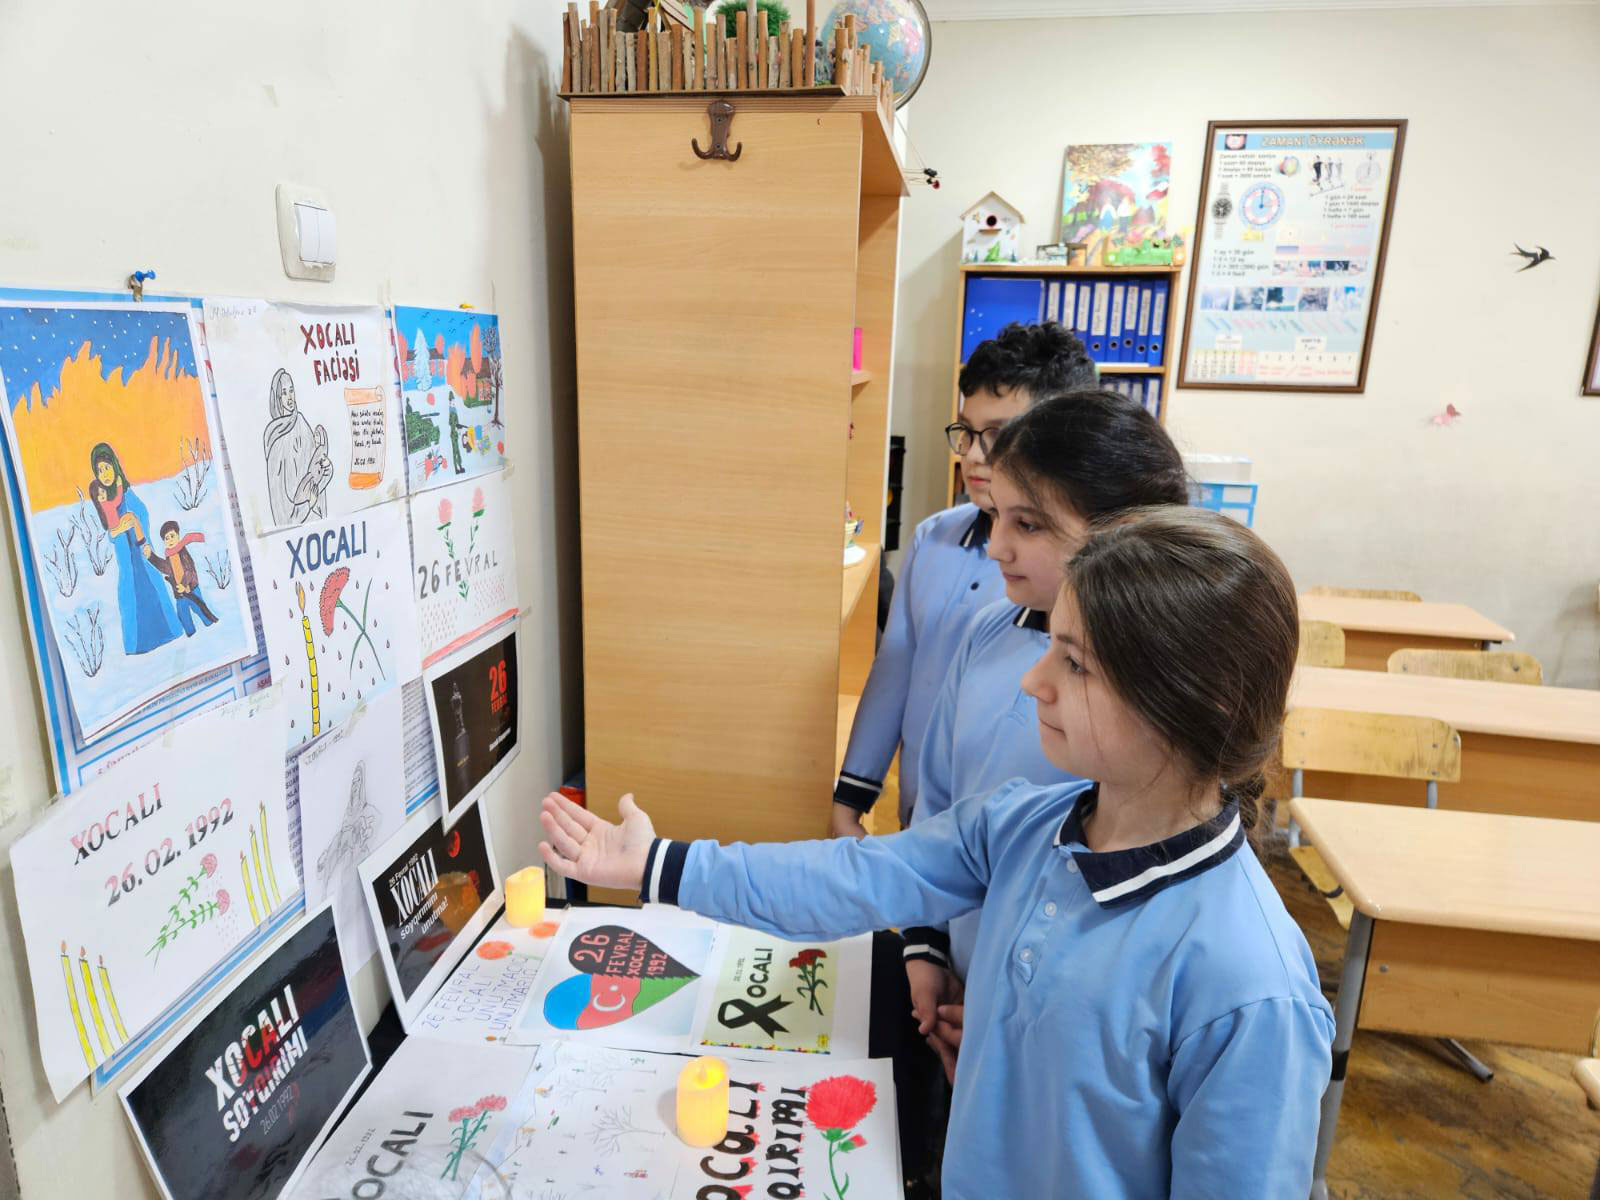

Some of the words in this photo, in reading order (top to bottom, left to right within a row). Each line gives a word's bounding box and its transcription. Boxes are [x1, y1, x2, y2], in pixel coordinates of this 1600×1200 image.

[300, 322, 355, 355] XOCALI
[286, 521, 367, 579] XOCALI
[418, 560, 440, 600] 26
[446, 550, 498, 587] FEVRAL
[489, 659, 507, 701] 26
[70, 783, 163, 865] XOCALI
[390, 847, 440, 928] XOCALI
[574, 934, 610, 963] 26
[605, 931, 635, 974] FEVRAL
[627, 939, 649, 975] XOCALI
[647, 952, 668, 976] 1992
[205, 984, 299, 1112] XOCALI
[320, 1110, 434, 1200] OCALI
